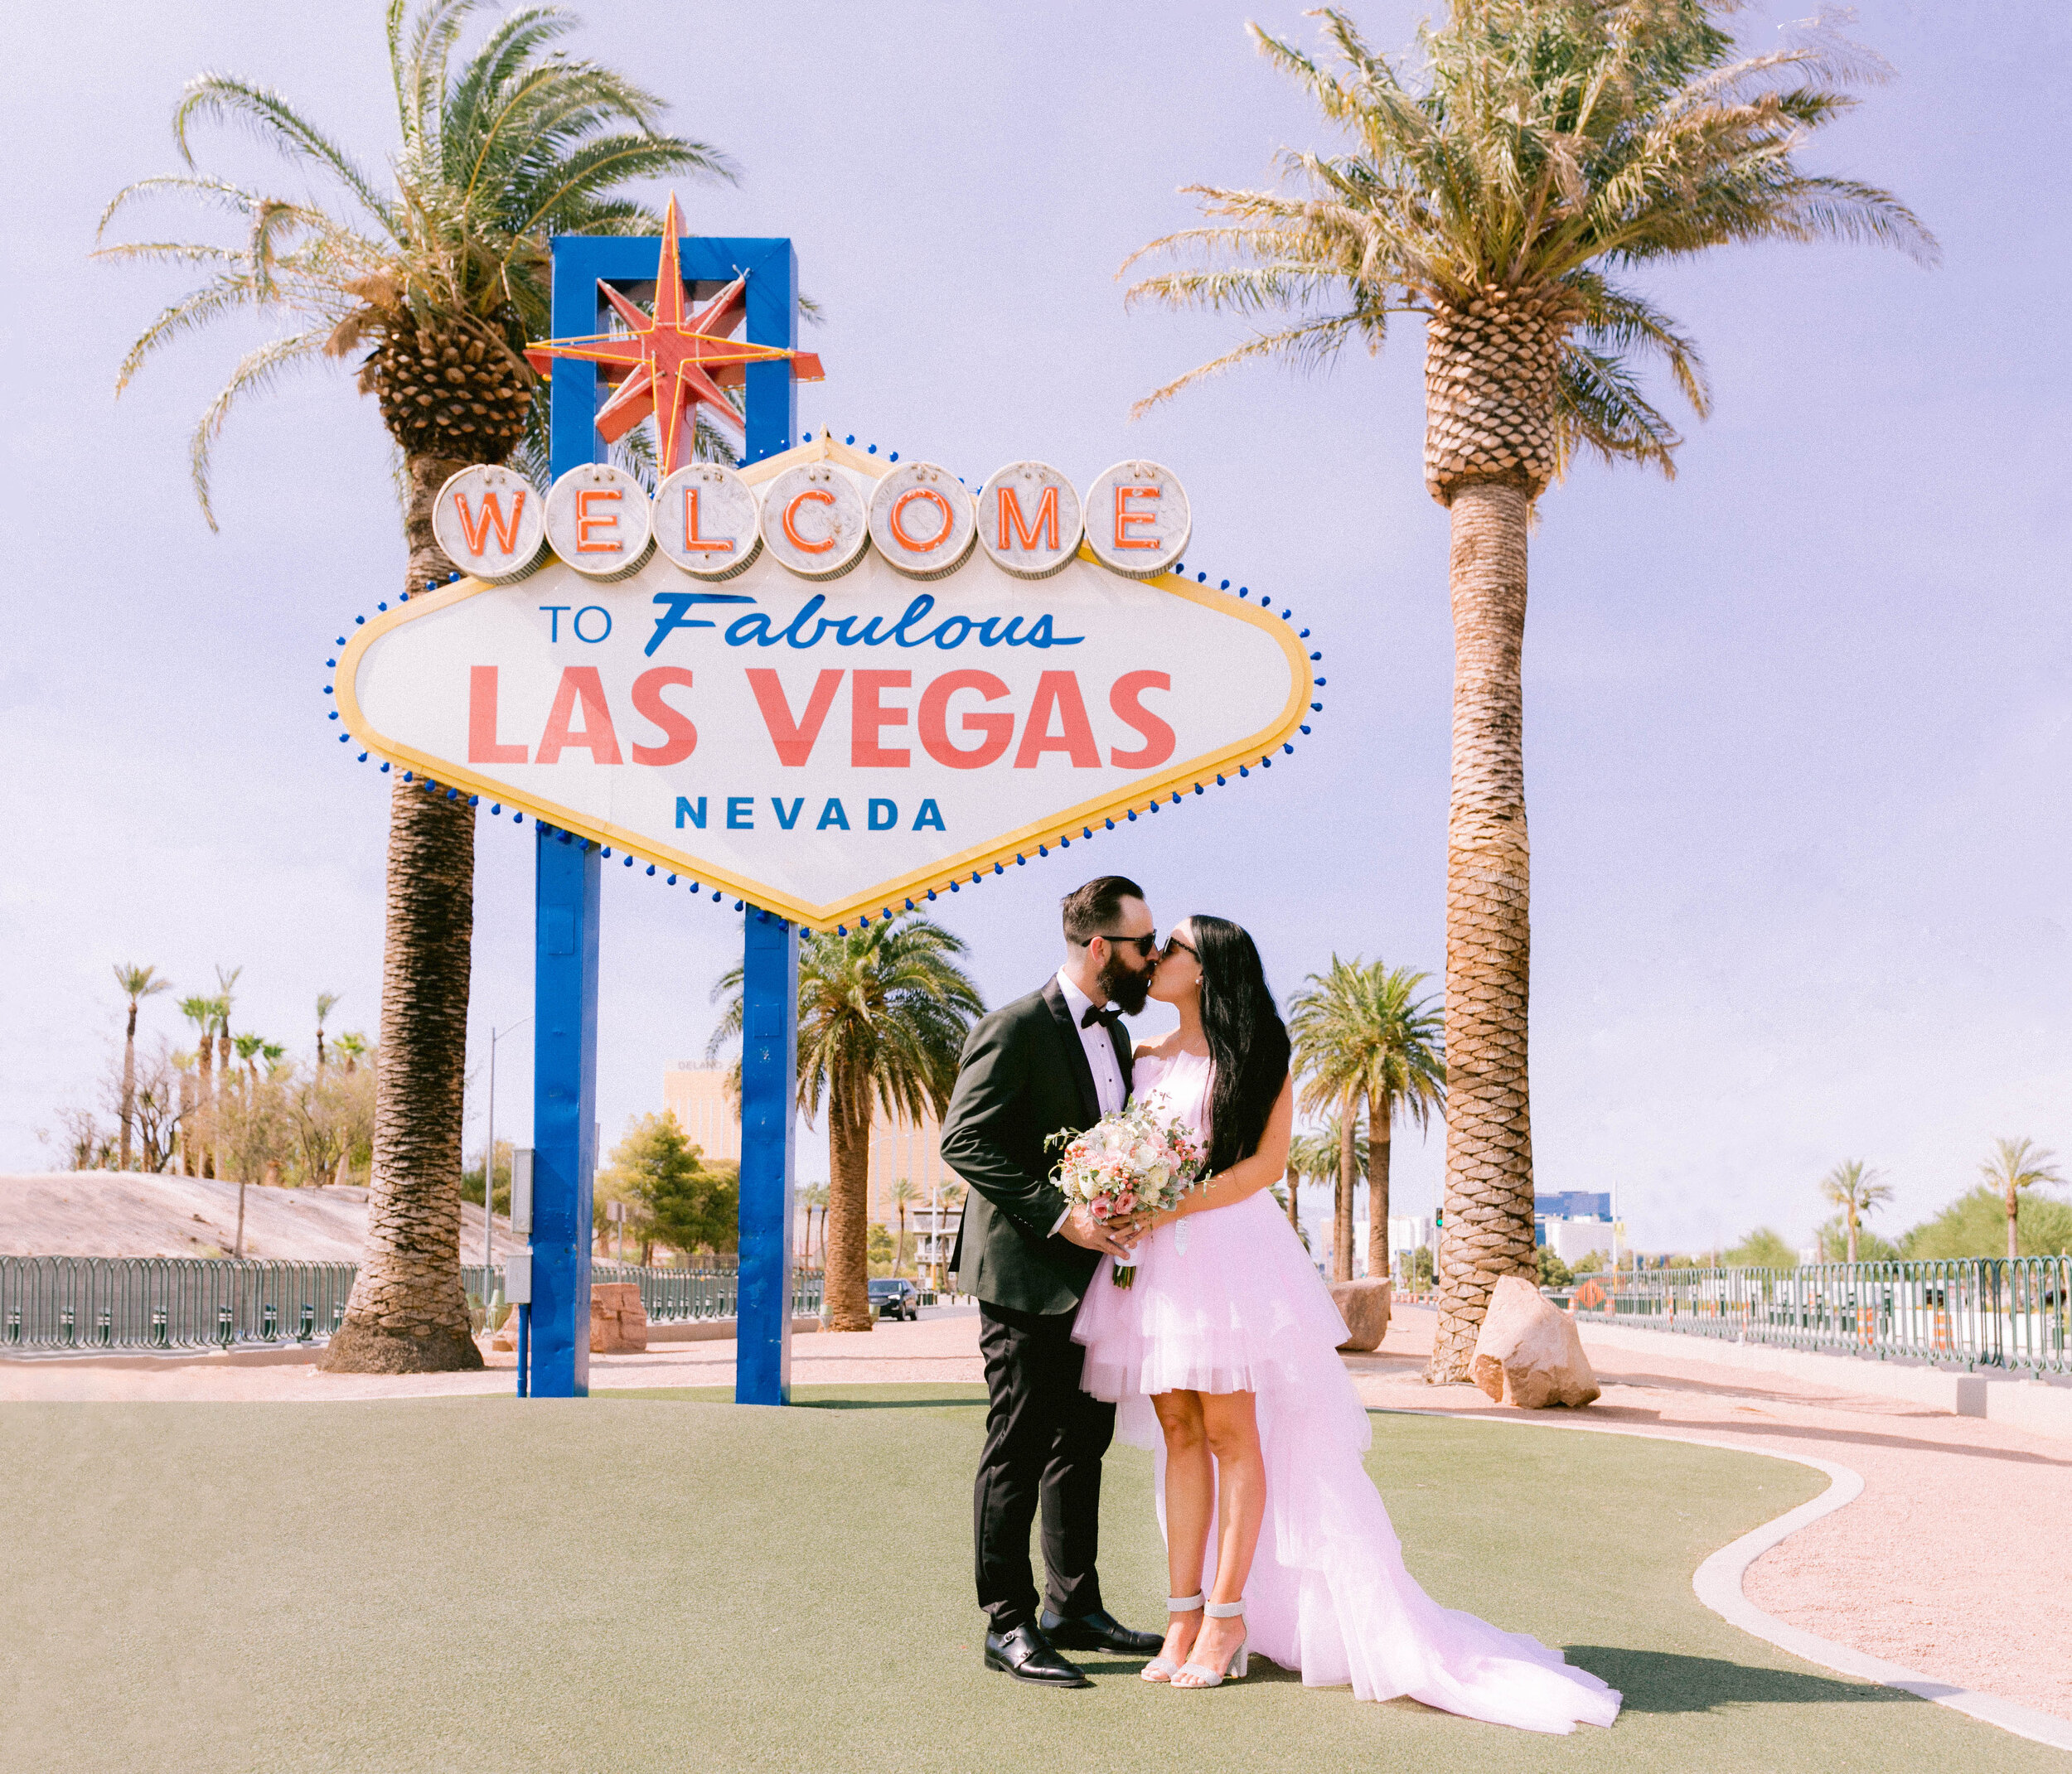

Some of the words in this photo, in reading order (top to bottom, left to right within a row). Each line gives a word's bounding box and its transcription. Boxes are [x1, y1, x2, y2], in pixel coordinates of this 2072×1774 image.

[454, 486, 1160, 556] WELCOME
[539, 606, 612, 644] TO
[644, 592, 1085, 657] Fabulous
[467, 665, 698, 766] LAS
[745, 668, 1176, 770] VEGAS
[675, 796, 946, 832] NEVADA
